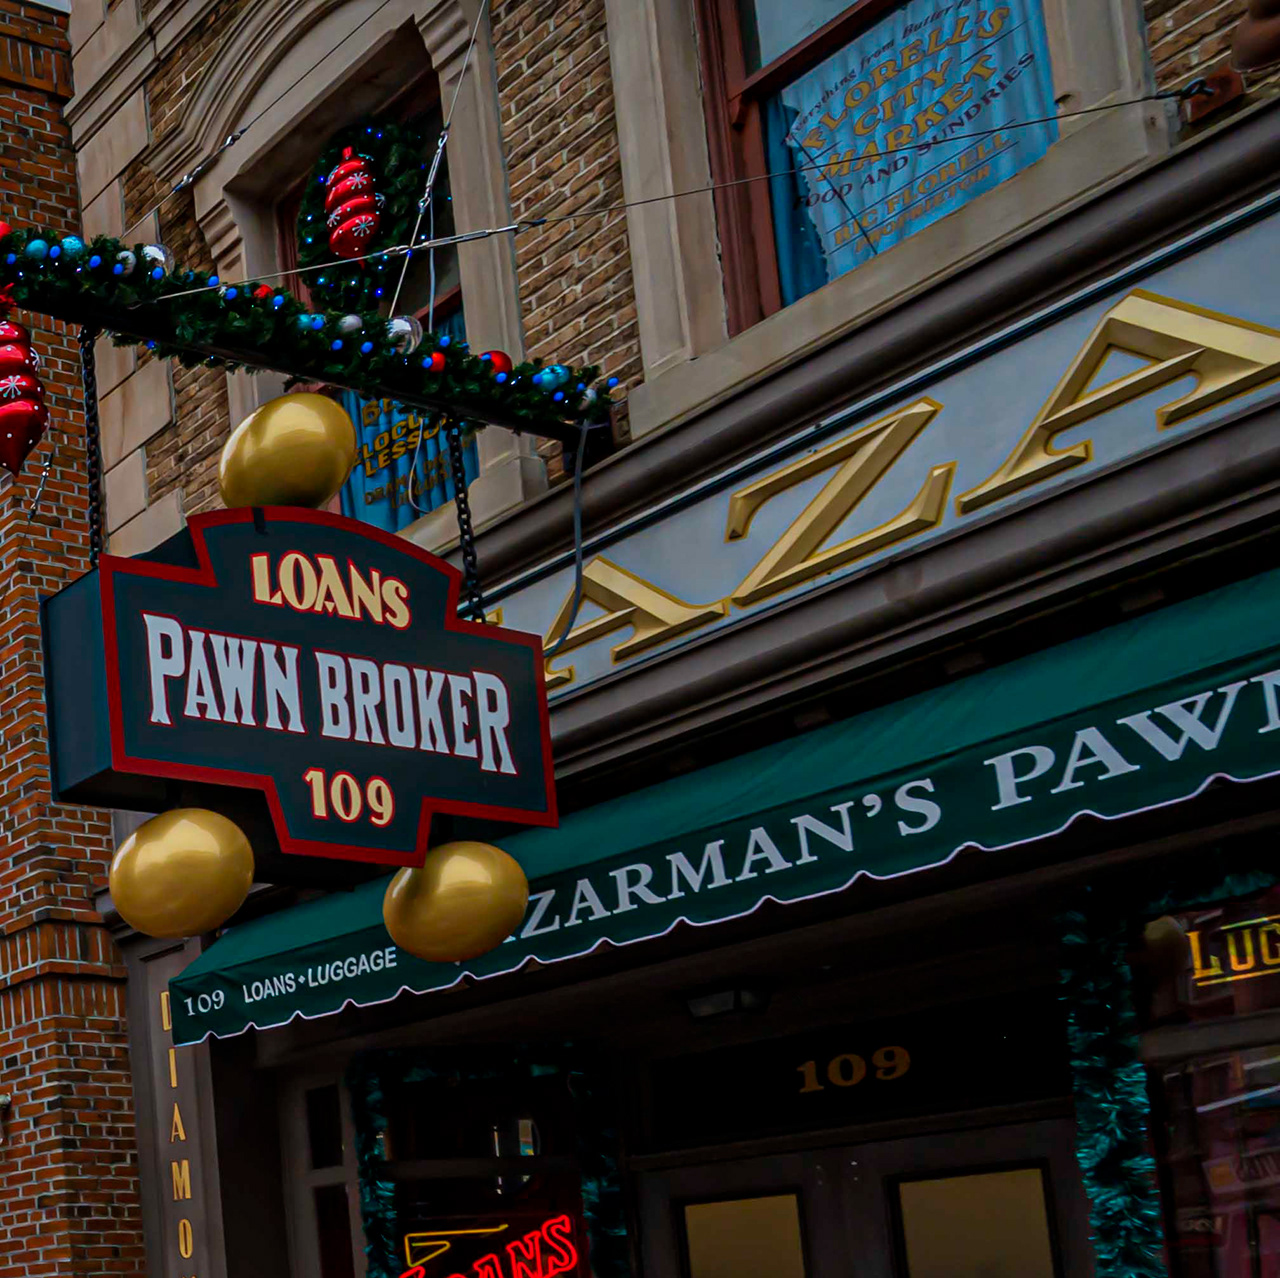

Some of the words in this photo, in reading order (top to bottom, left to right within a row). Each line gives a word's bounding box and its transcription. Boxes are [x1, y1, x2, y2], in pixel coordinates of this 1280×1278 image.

[801, 6, 1011, 149] FLORELL'S
[816, 53, 998, 182] MARKET
[853, 56, 954, 137] CITY
[861, 156, 909, 190] AND
[886, 131, 1012, 214] FLORELL
[249, 550, 412, 630] LOANS
[141, 611, 307, 735] PAWN
[315, 651, 518, 776] BROKER
[303, 767, 395, 828] 109
[503, 777, 943, 944] ZARMAN'S
[184, 989, 226, 1017] 109
[243, 972, 297, 1004] LOANS
[307, 946, 398, 988] LUGGAGE
[796, 1045, 911, 1093] 109
